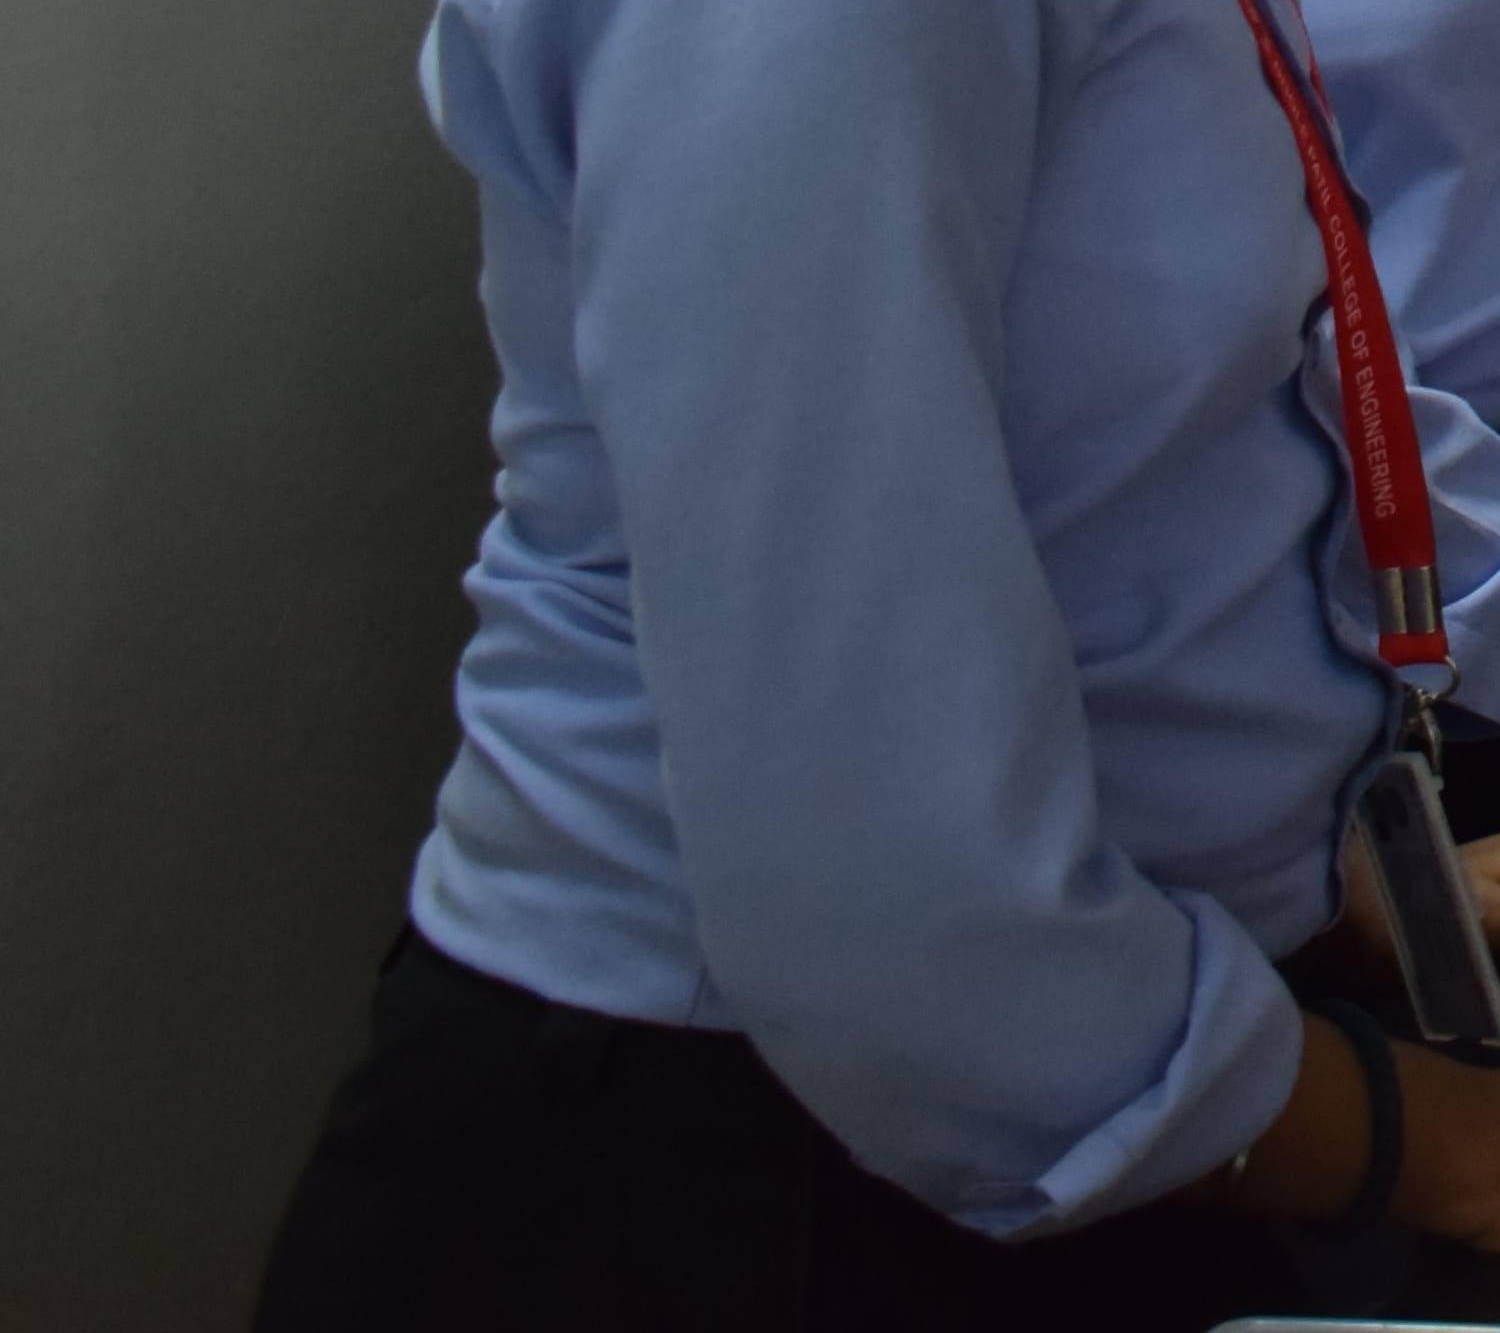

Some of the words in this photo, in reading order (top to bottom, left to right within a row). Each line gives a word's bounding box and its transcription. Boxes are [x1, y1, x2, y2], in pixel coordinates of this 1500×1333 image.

[1329, 213, 1362, 330] COLLEGE
[1351, 330, 1371, 362] OF
[1355, 363, 1397, 520] ENGINEERING
